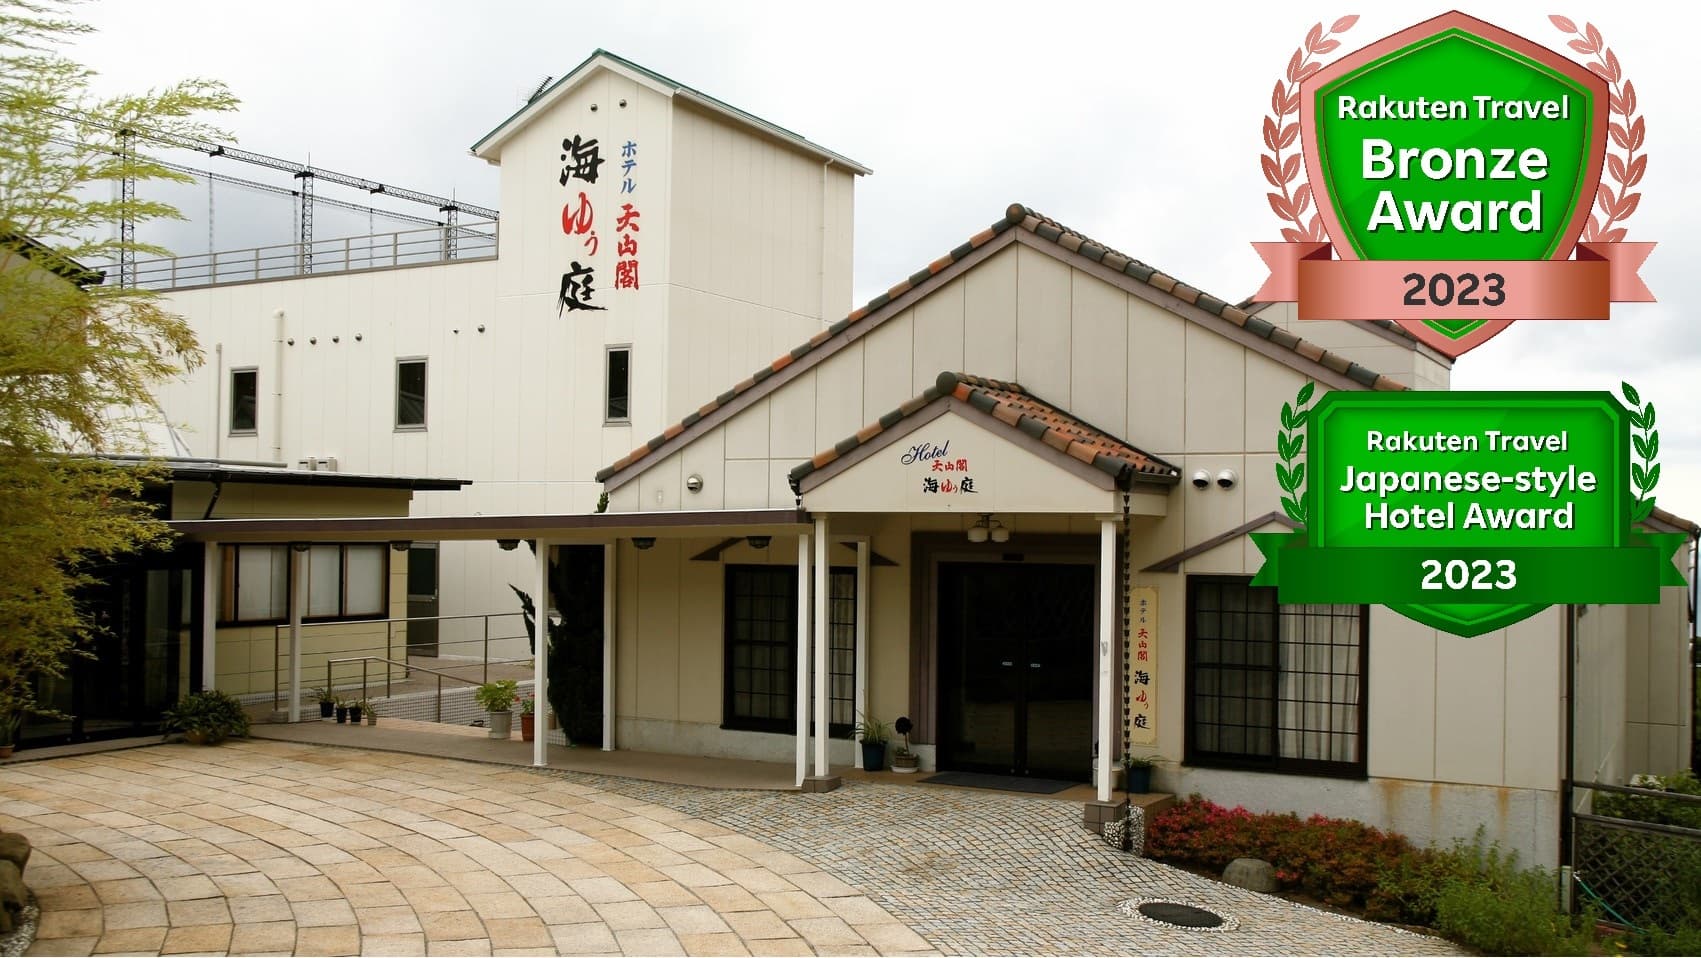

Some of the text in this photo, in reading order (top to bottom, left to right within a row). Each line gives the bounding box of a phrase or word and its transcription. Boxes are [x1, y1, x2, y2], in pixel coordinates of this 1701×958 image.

[615, 140, 640, 290] ホテル 天山閣
[900, 439, 950, 465] Hotel
[932, 458, 968, 472] 天山閣
